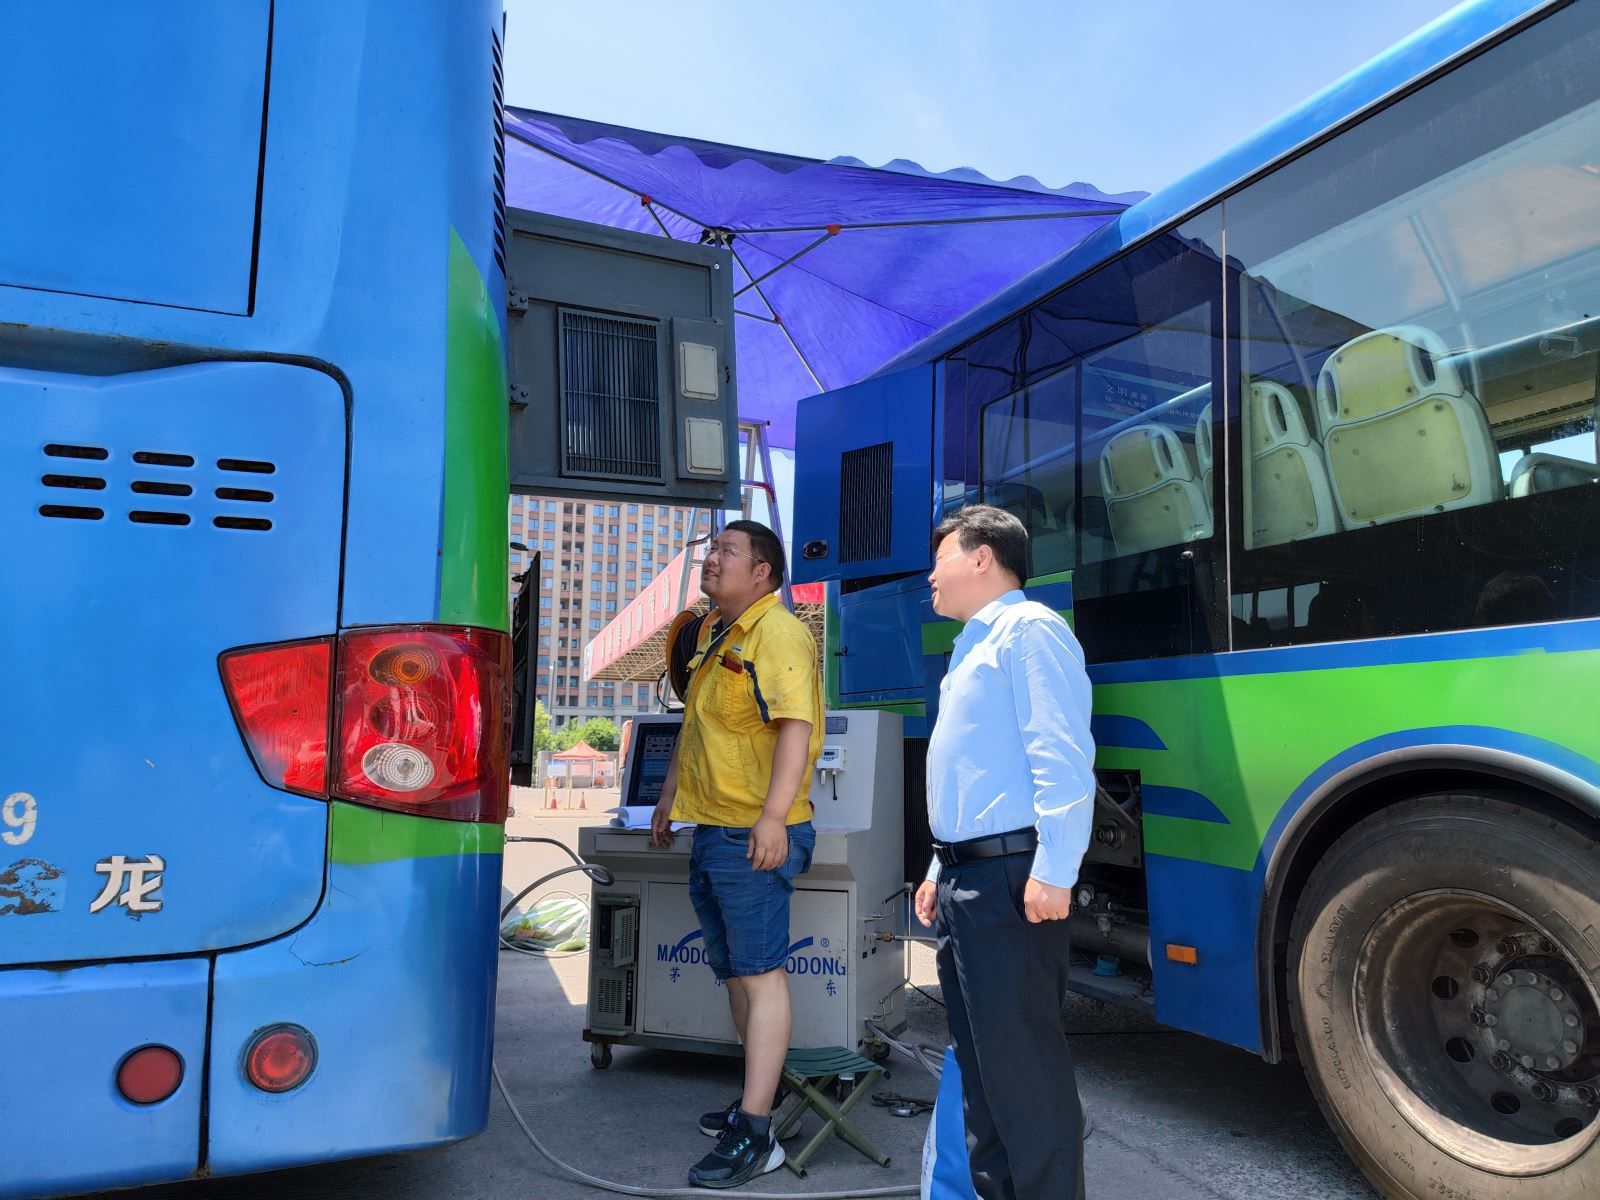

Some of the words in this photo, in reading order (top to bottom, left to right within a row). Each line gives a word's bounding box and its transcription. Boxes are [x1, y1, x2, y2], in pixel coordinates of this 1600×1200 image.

[2, 792, 37, 845] 9
[89, 854, 165, 914] 龙
[657, 943, 710, 966] MAODO
[785, 955, 847, 977] ODONG
